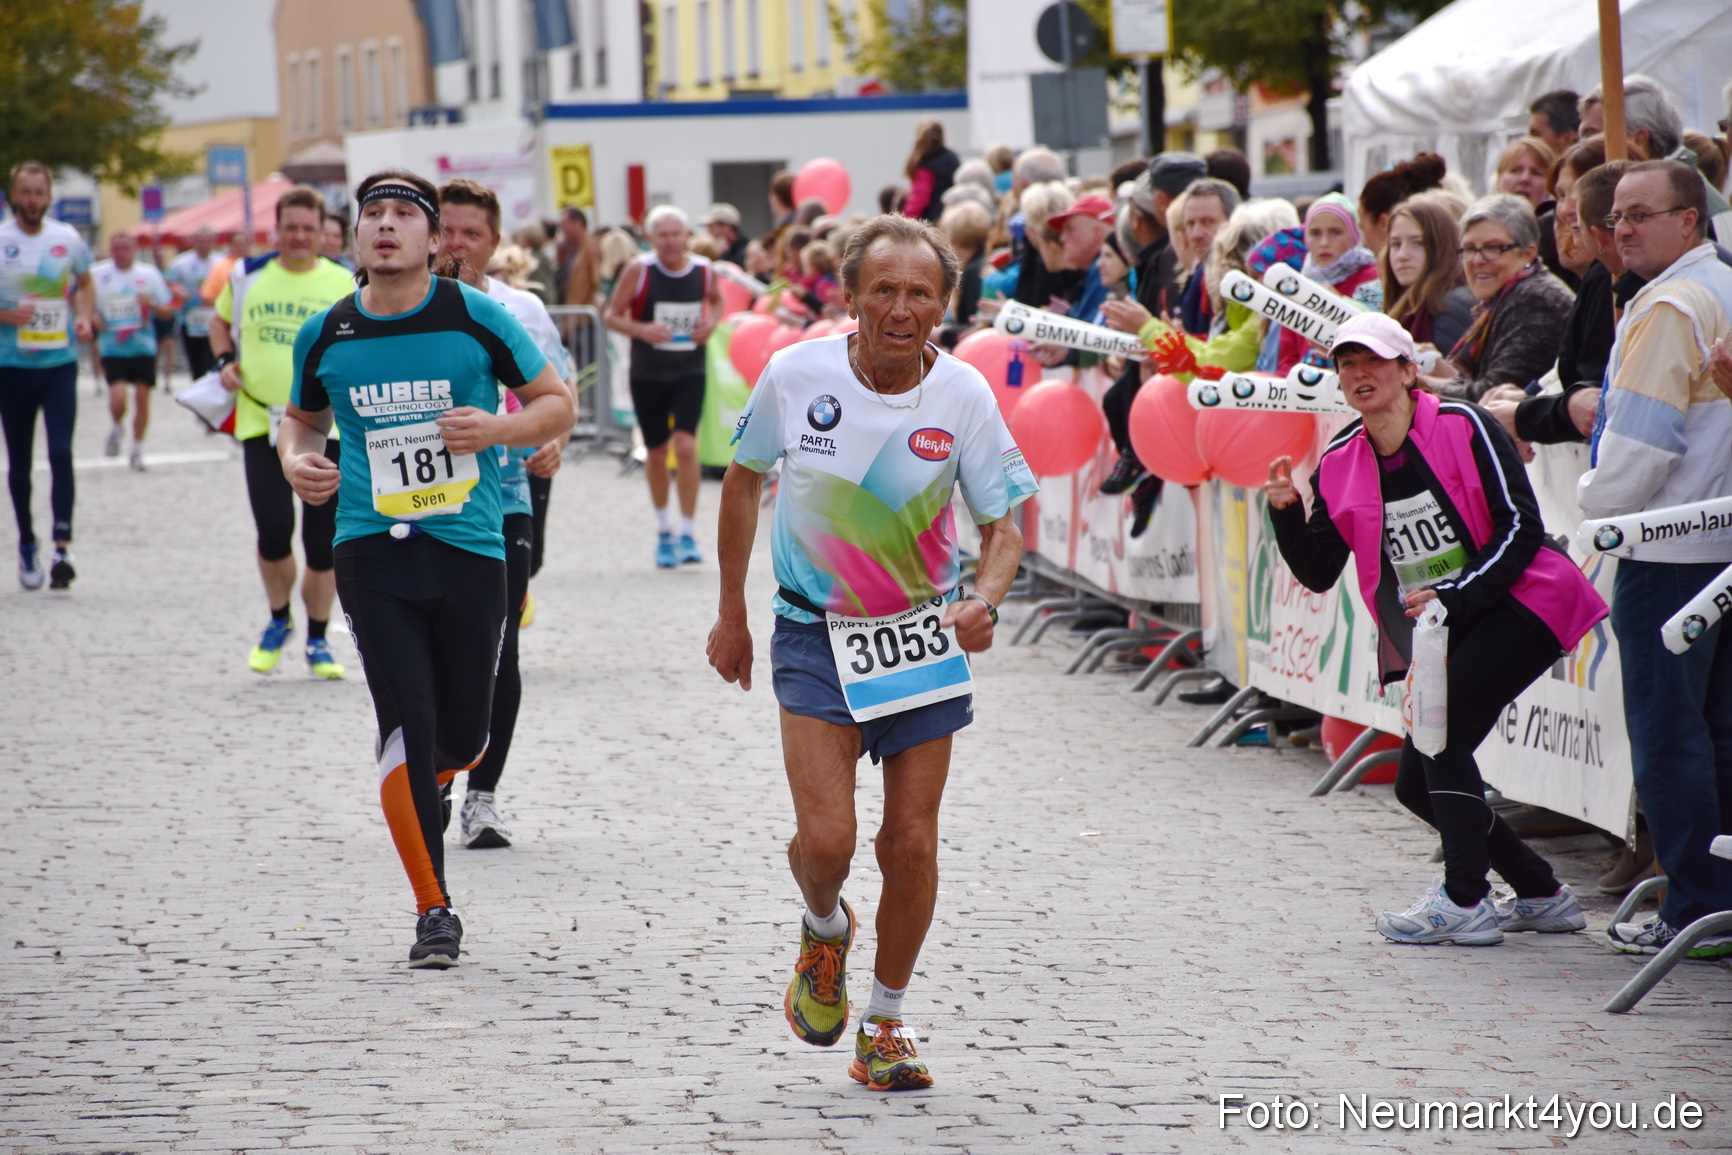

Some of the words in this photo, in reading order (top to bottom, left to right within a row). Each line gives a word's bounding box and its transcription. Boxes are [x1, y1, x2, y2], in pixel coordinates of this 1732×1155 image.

[562, 165, 585, 195] D
[1262, 298, 1314, 333] BMW
[1303, 293, 1351, 324] BMW
[1035, 323, 1080, 342] BMW
[349, 380, 452, 407] HUBER
[812, 395, 840, 410] BMW
[373, 401, 449, 414] TECHNOLOGY
[374, 415, 398, 424] WASTE
[398, 413, 423, 422] WATER
[424, 411, 444, 420] Soluti
[368, 438, 403, 450] PARTL
[404, 433, 444, 445] Neuma
[799, 443, 836, 457] Neumarkt
[801, 434, 837, 449] PARTL
[915, 434, 952, 454] Hervis
[391, 445, 454, 487] 181
[1003, 459, 1025, 472] erMar
[412, 492, 446, 509] Sven
[1396, 500, 1438, 520] Neumarkt
[1385, 512, 1461, 561] 5105
[1712, 585, 1732, 615] B
[875, 603, 930, 627] Nmarkt
[846, 614, 949, 675] 3053
[1523, 704, 1603, 769] neumarkt
[1428, 914, 1447, 928] N
